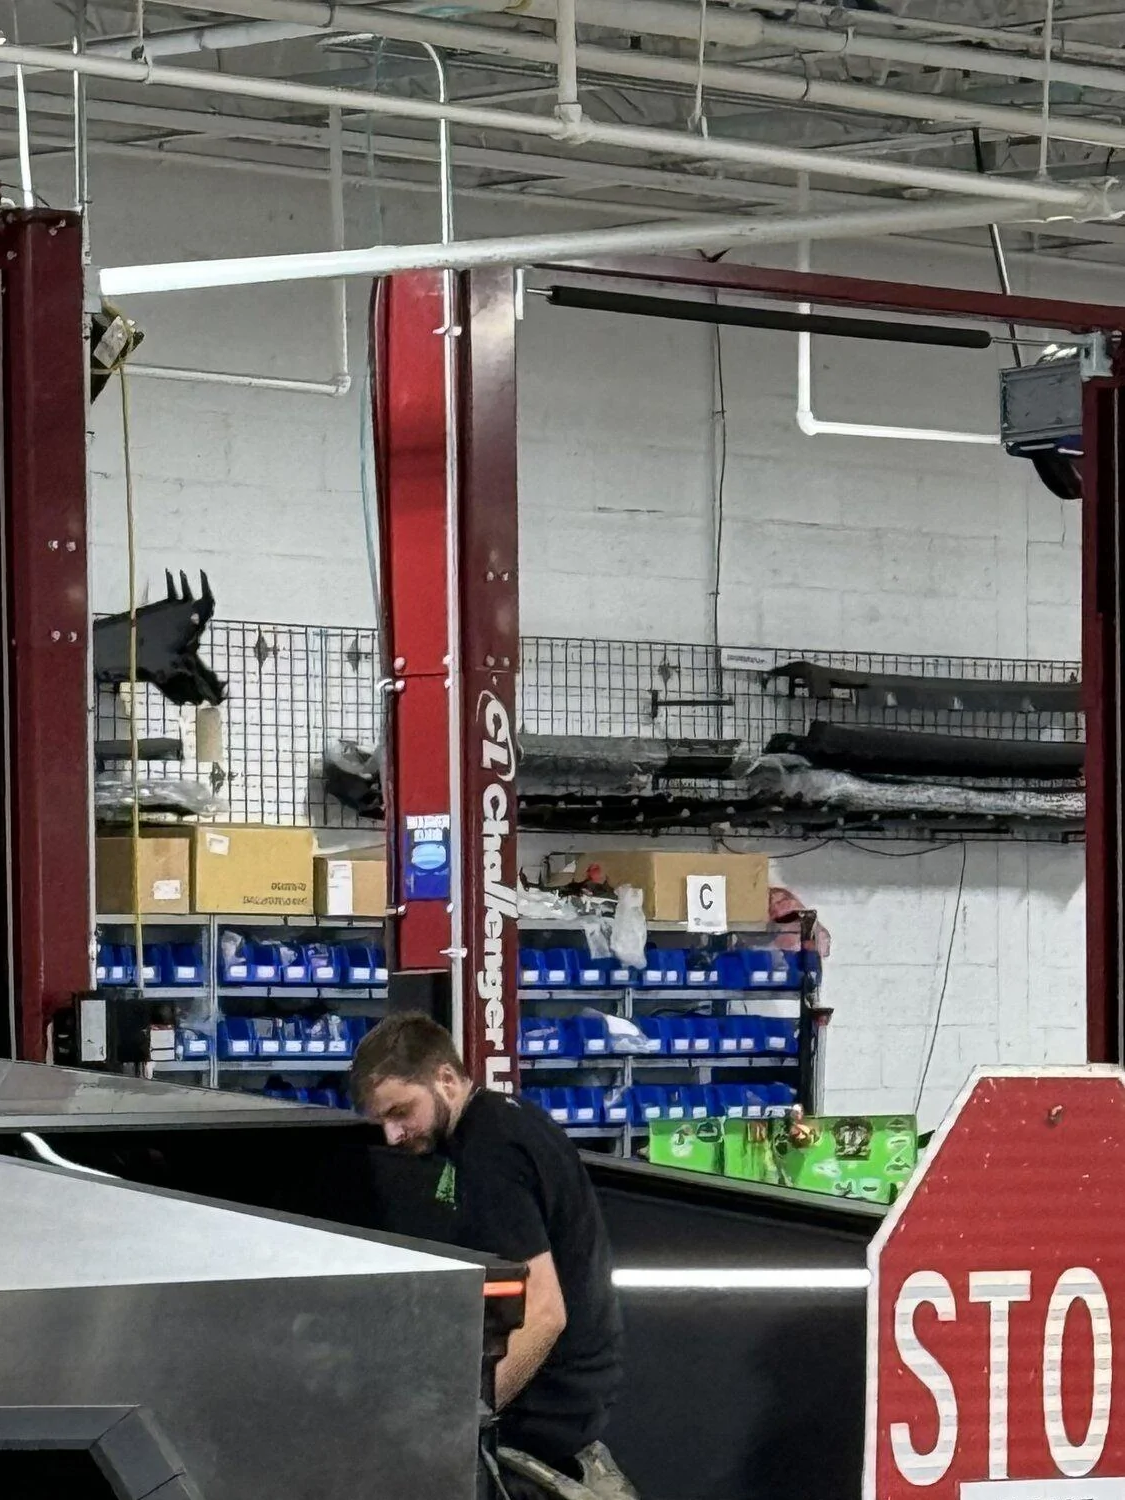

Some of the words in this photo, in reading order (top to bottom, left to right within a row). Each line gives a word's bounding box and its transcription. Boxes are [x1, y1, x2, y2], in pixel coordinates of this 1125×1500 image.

[477, 783, 518, 1051] Challenger
[699, 882, 714, 911] C
[889, 1265, 1113, 1487] STO
